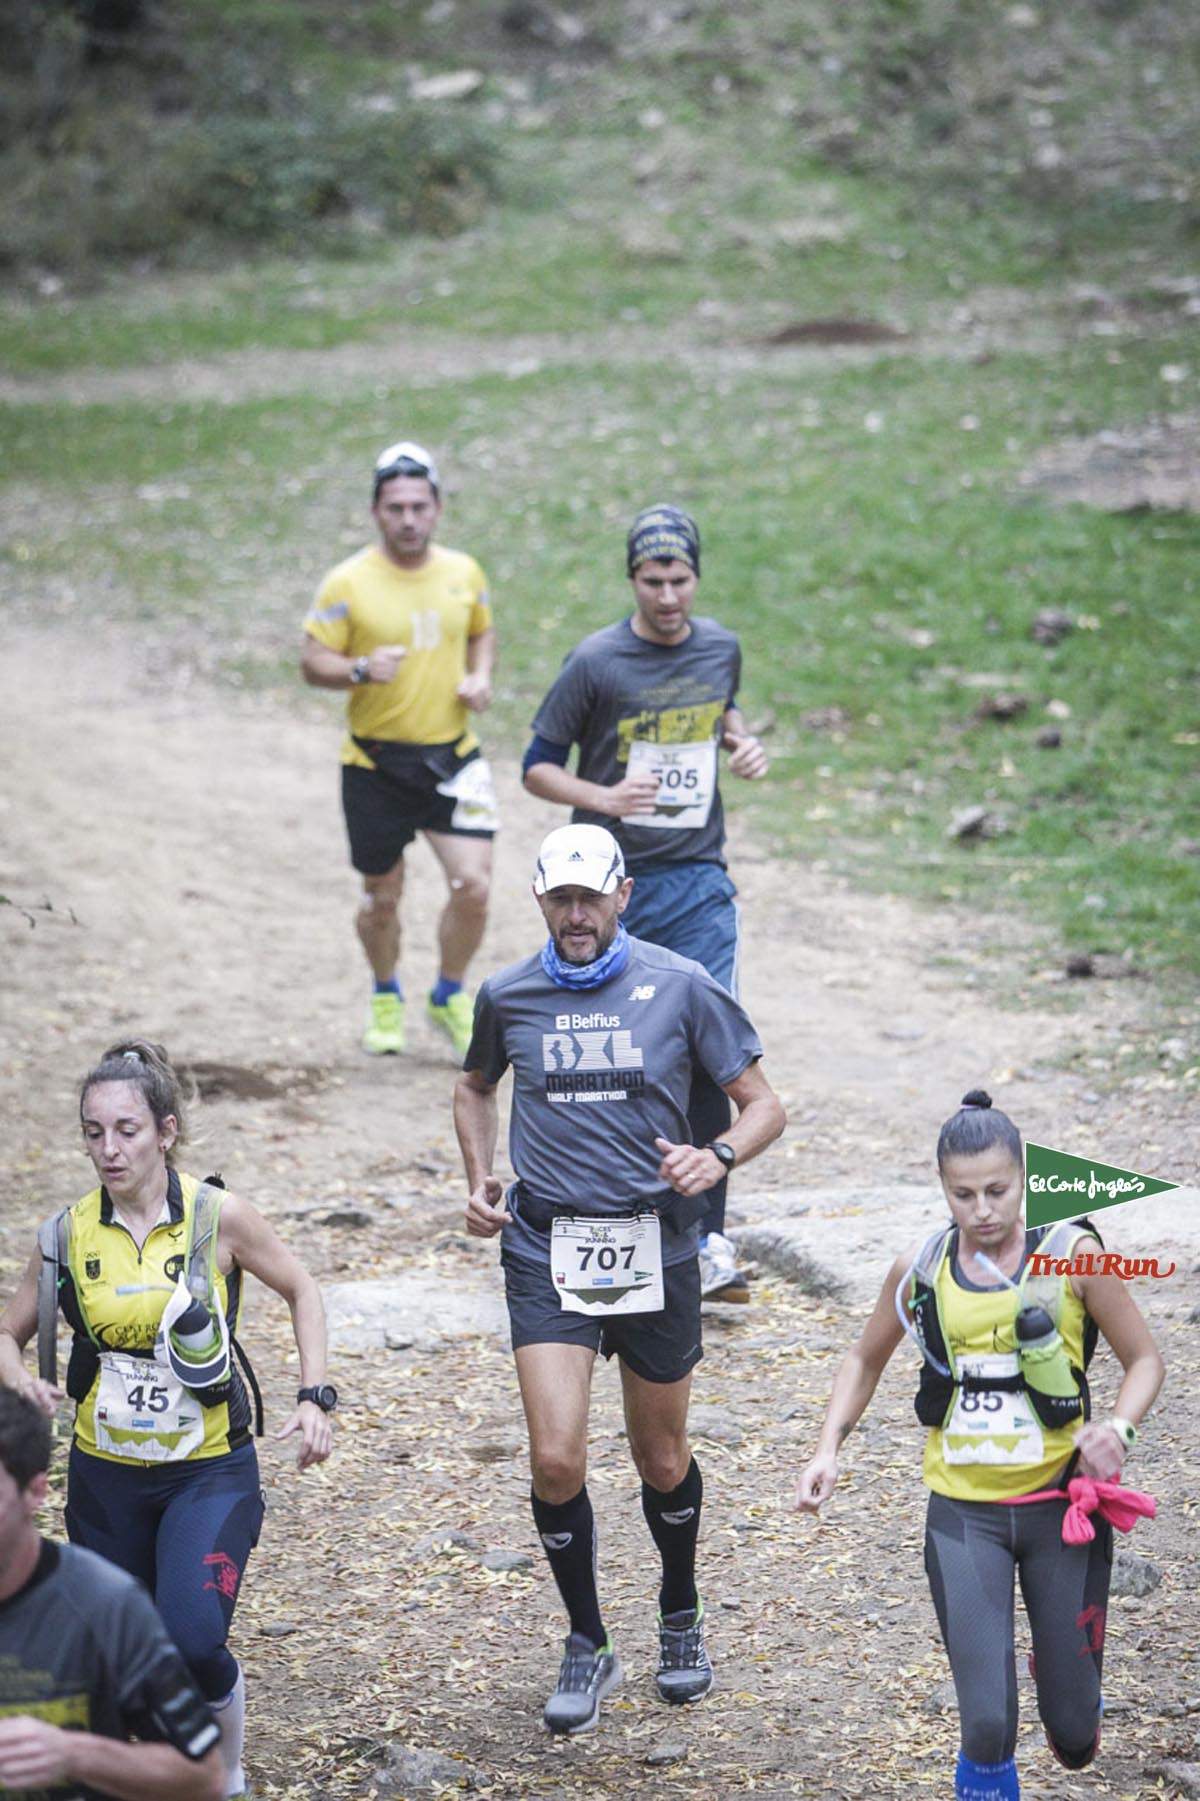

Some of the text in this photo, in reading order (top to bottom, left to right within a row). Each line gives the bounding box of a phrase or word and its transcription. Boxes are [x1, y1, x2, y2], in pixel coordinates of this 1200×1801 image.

[571, 1012, 621, 1030] Belfius
[546, 1070, 644, 1091] MARATHON
[574, 1090, 627, 1103] MARATHON
[576, 1244, 636, 1272] 707
[127, 1385, 170, 1413] 45
[960, 1388, 1003, 1413] 85
